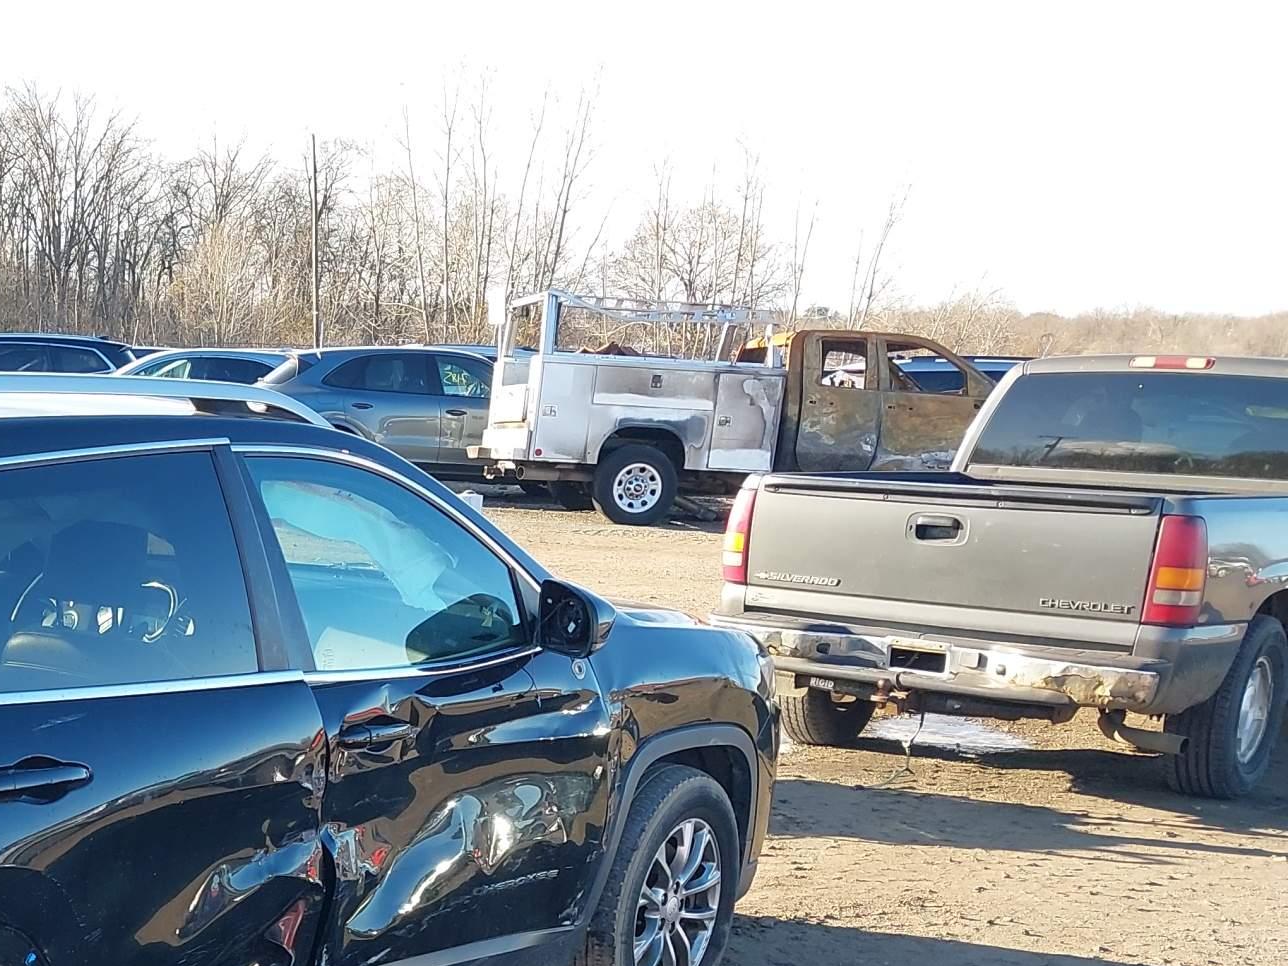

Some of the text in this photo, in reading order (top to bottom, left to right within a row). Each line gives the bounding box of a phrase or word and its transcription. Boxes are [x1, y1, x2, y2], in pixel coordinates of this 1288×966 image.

[767, 571, 841, 587] SILVERADO
[1039, 598, 1136, 615] CHEVROLET
[809, 676, 834, 689] RIGID
